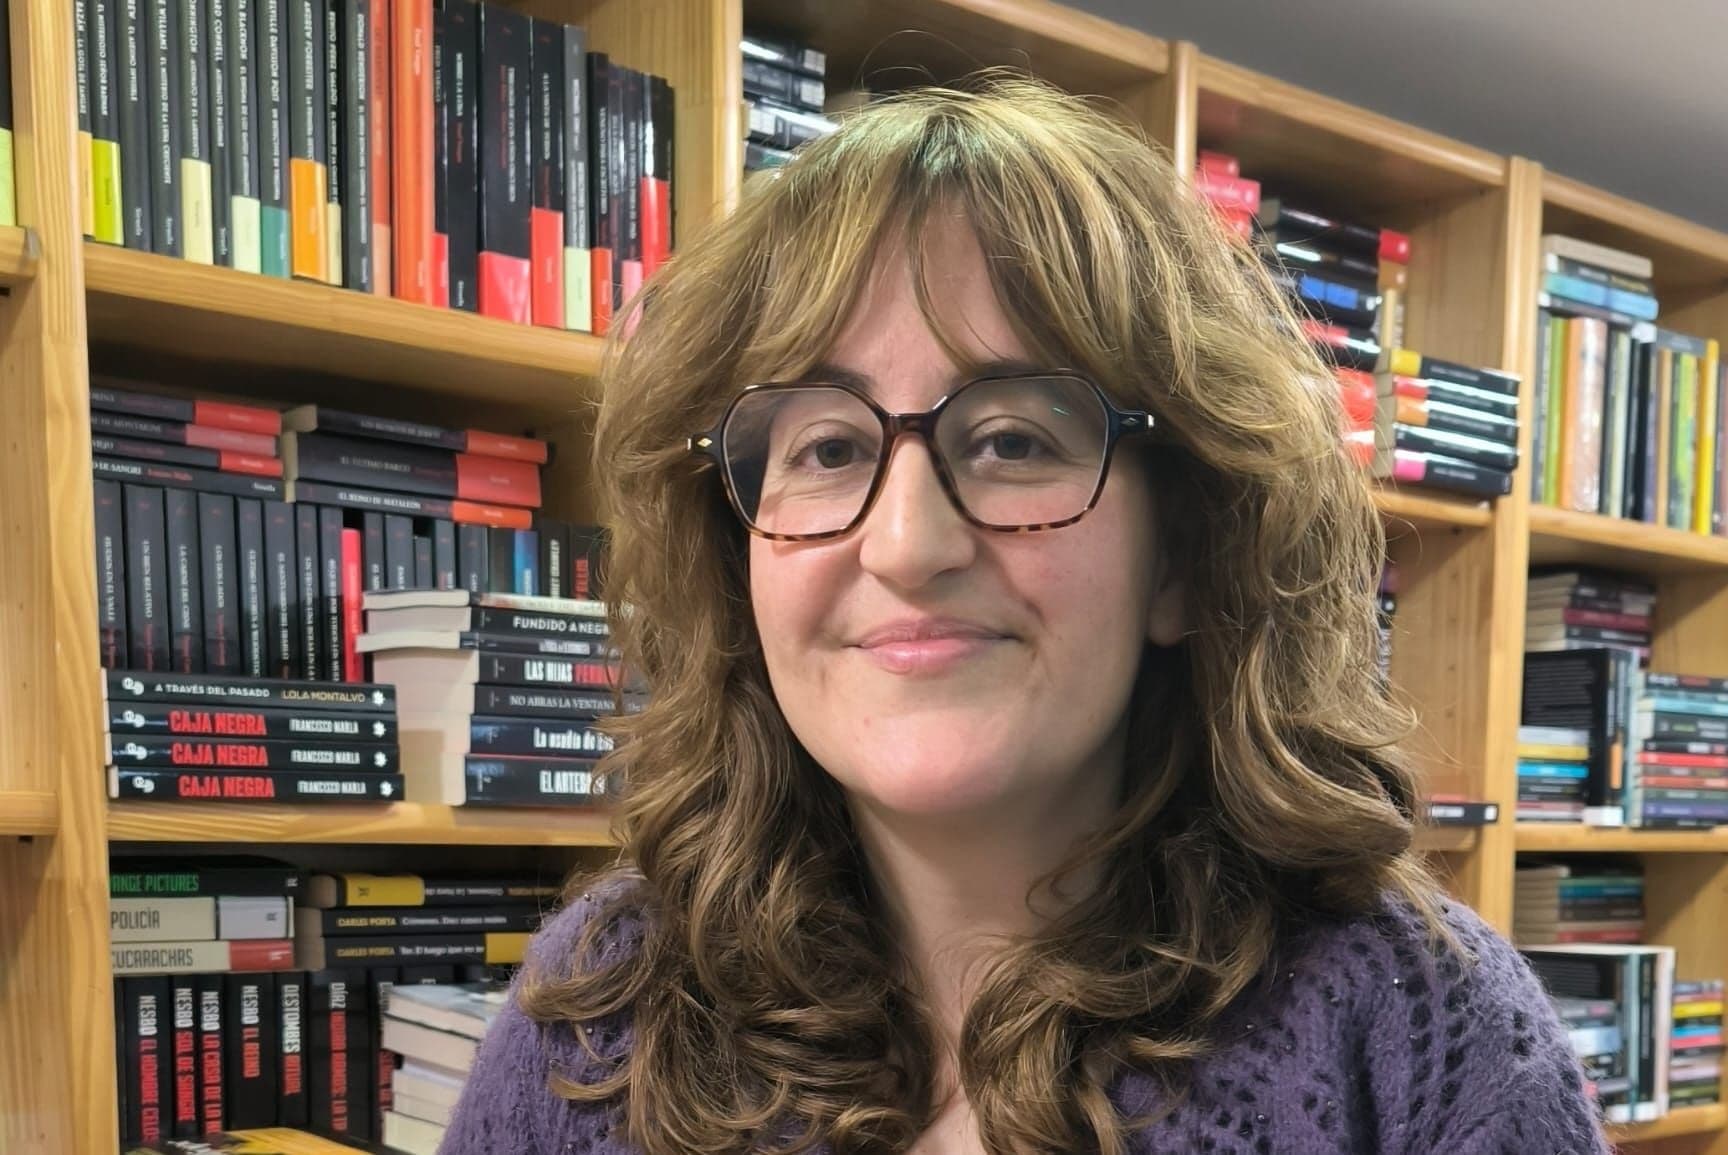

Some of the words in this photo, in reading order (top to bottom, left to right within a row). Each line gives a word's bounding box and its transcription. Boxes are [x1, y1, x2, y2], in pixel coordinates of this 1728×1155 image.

[513, 616, 567, 632] FUNDIDO
[568, 621, 578, 632] A
[524, 660, 544, 681] LAS
[545, 662, 573, 682] HIJAS
[155, 683, 163, 692] A
[165, 683, 205, 695] TRAVÉS
[207, 686, 227, 696] DEL
[229, 687, 270, 698] PASADO
[282, 689, 311, 700] LOLA
[310, 691, 366, 703] MONTALVO
[509, 695, 526, 706] NO
[559, 698, 572, 709] LA
[170, 709, 212, 733] CAJA
[214, 711, 267, 736] NEGRA
[172, 741, 215, 765] CAJA
[216, 743, 269, 767] NEGRA
[178, 774, 221, 797] CAJA
[223, 775, 275, 798] NEGRA
[539, 770, 553, 793] EL
[144, 873, 200, 893] PICTURES
[112, 906, 161, 930] POLICÍA
[369, 916, 396, 927] PORTA
[112, 948, 194, 969] UCARACHAS
[329, 982, 349, 1009] DÍAZ
[281, 984, 302, 1053] DESTOMBES
[176, 1031, 194, 1054] SOL
[203, 1034, 221, 1049] LA
[242, 1027, 260, 1041] EL
[140, 1039, 158, 1052] EL
[177, 1056, 195, 1073] DE
[203, 1051, 222, 1084] CASA
[243, 1042, 261, 1078] REINO
[141, 1054, 159, 1105] HOMBRE
[283, 1055, 302, 1096] RITUAL
[177, 1074, 196, 1121] SANGRE
[204, 1086, 222, 1101] DE
[205, 1103, 222, 1119] LA
